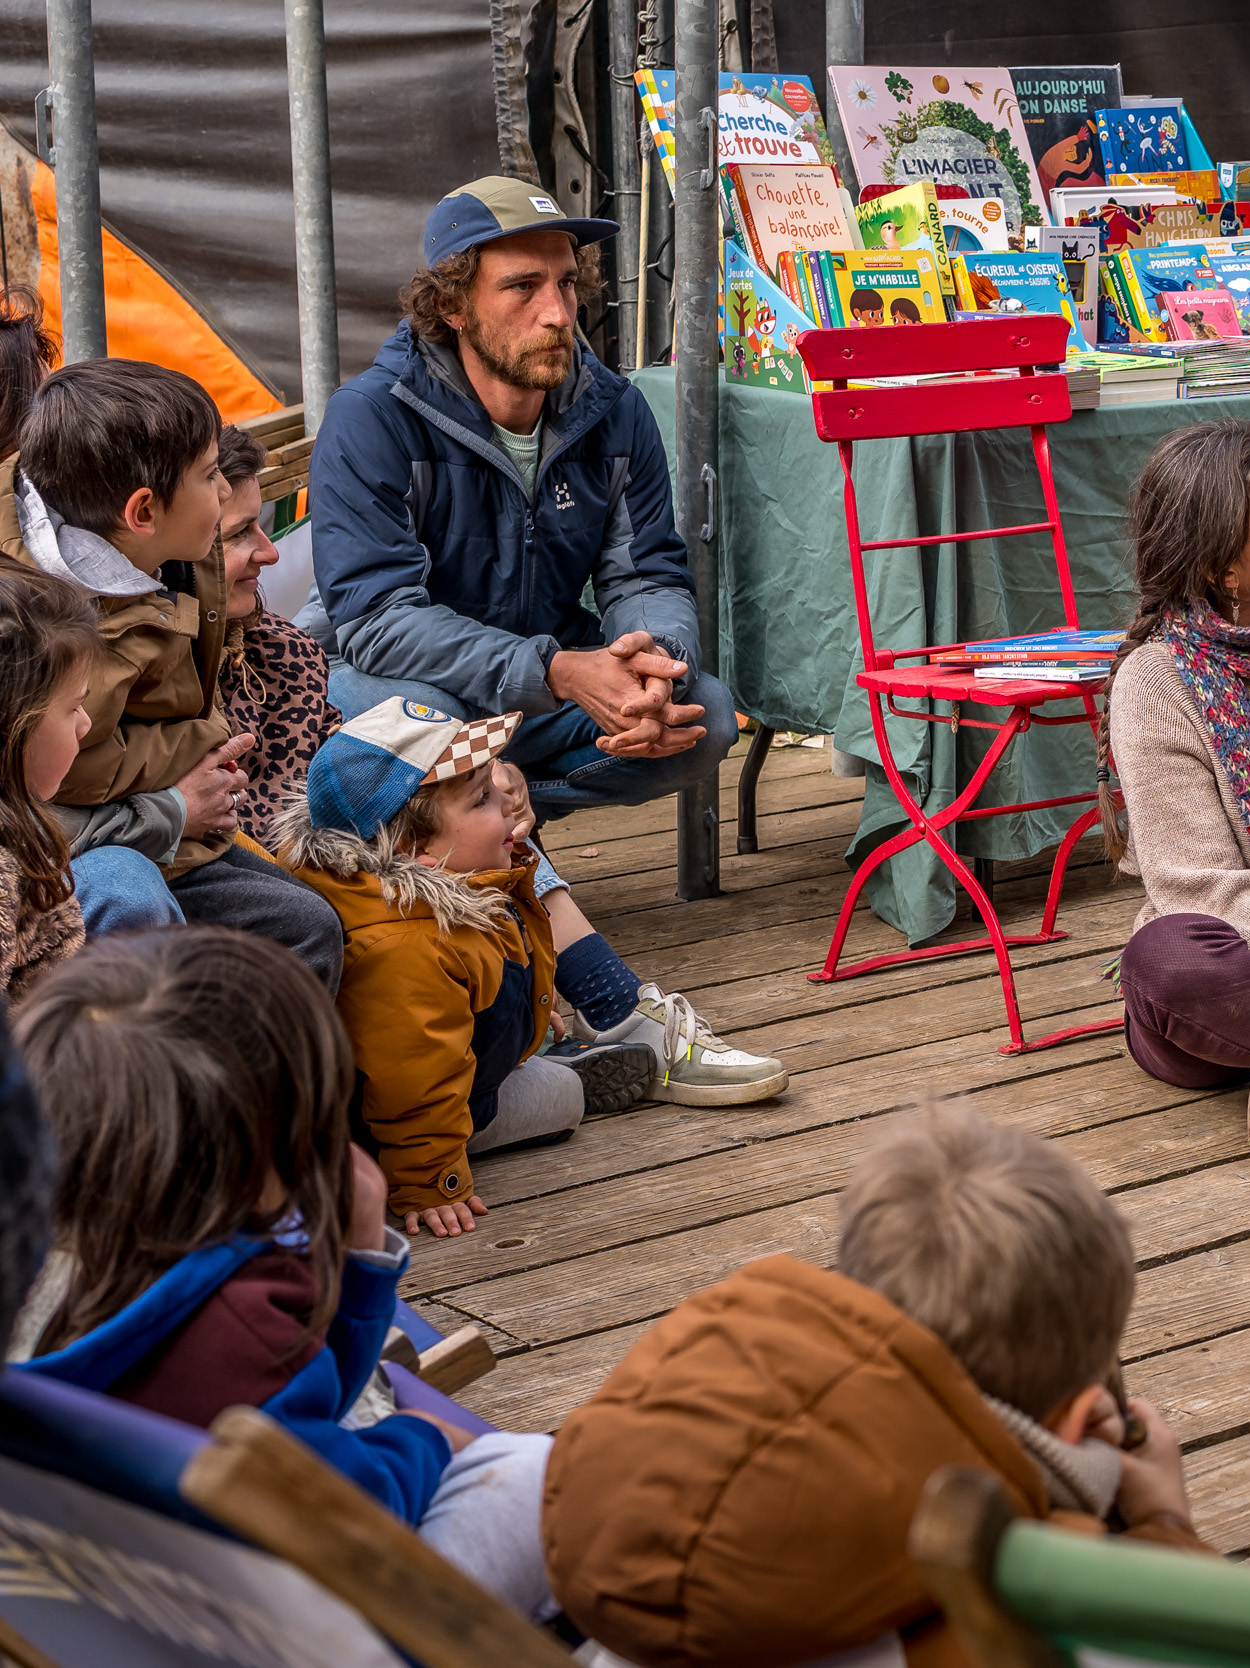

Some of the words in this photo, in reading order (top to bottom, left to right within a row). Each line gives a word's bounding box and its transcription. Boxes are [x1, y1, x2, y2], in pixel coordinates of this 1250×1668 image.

[1016, 80, 1106, 95] AUJOURD'HUI
[1044, 99, 1088, 113] DANSE
[734, 132, 802, 157] trouve
[902, 158, 998, 175] L'IMAGIER
[756, 182, 828, 208] Chouette,
[788, 210, 807, 219] une
[952, 208, 989, 234] tourne
[1158, 210, 1194, 226] CHRIS
[768, 216, 842, 241] balançoire!
[928, 202, 948, 265] CANARD
[1146, 228, 1213, 247] HAUGHTON
[1150, 257, 1198, 269] PRINTEMPS
[728, 268, 744, 278] Jeux
[745, 268, 754, 277] de
[855, 275, 867, 285] JE
[869, 274, 918, 285] M'HABILLE
[730, 280, 753, 290] cartes
[1030, 277, 1050, 286] SAISONS
[1174, 296, 1188, 305] Les
